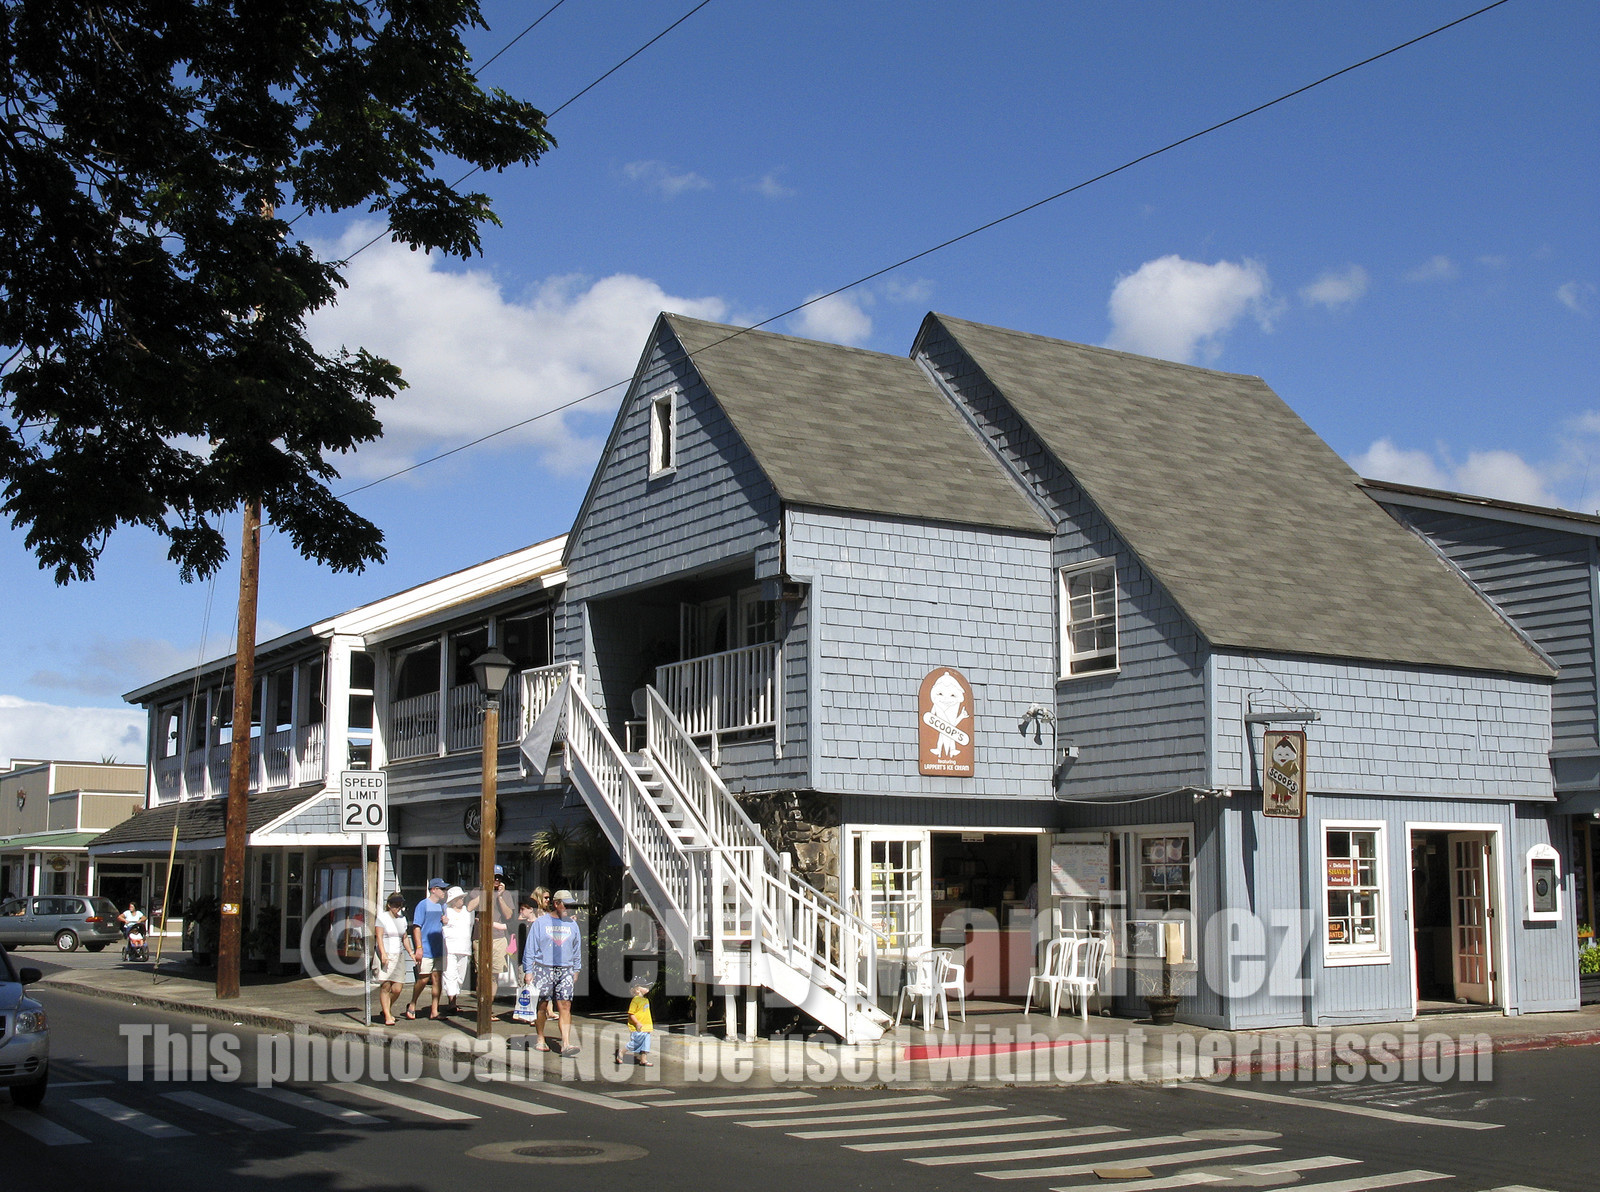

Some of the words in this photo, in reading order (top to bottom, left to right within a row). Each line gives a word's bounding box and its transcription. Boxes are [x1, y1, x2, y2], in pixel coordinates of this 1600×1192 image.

[928, 716, 964, 742] SCOOP'S
[344, 777, 383, 788] SPEED
[1269, 768, 1297, 791] SCOOPS
[349, 790, 378, 800] LIMIT
[346, 803, 383, 826] 20
[1328, 931, 1344, 939] ANTED
